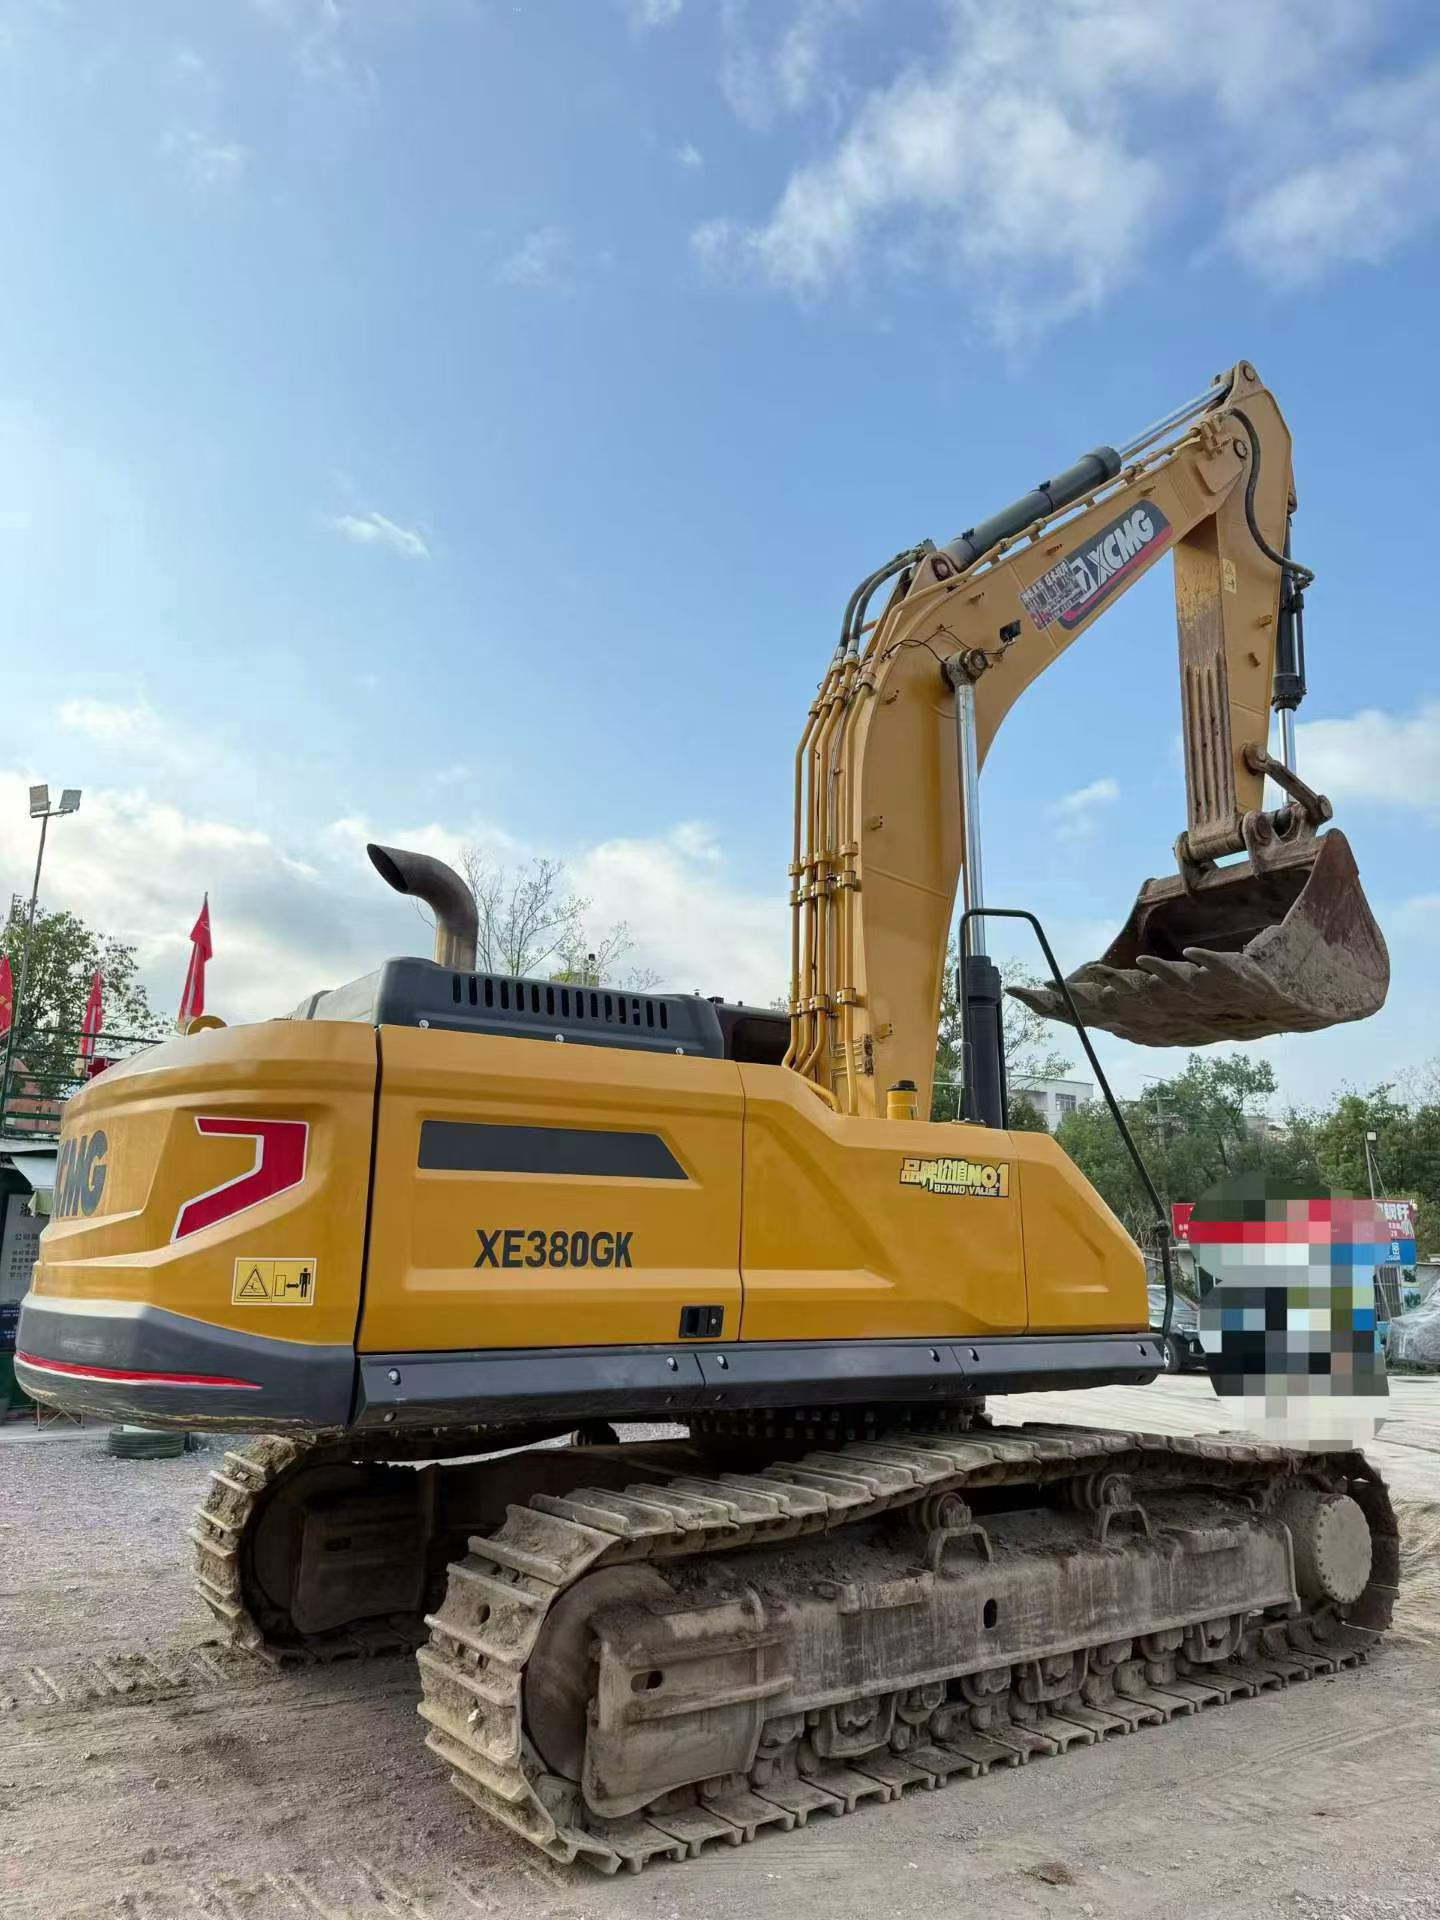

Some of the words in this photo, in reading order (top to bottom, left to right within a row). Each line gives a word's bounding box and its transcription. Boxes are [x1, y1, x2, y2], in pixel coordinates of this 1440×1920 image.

[1087, 508, 1154, 587] XCMG
[934, 1183, 965, 1195] BRAND
[969, 1186, 998, 1196] VALUE
[474, 1229, 634, 1268] XE380GK
